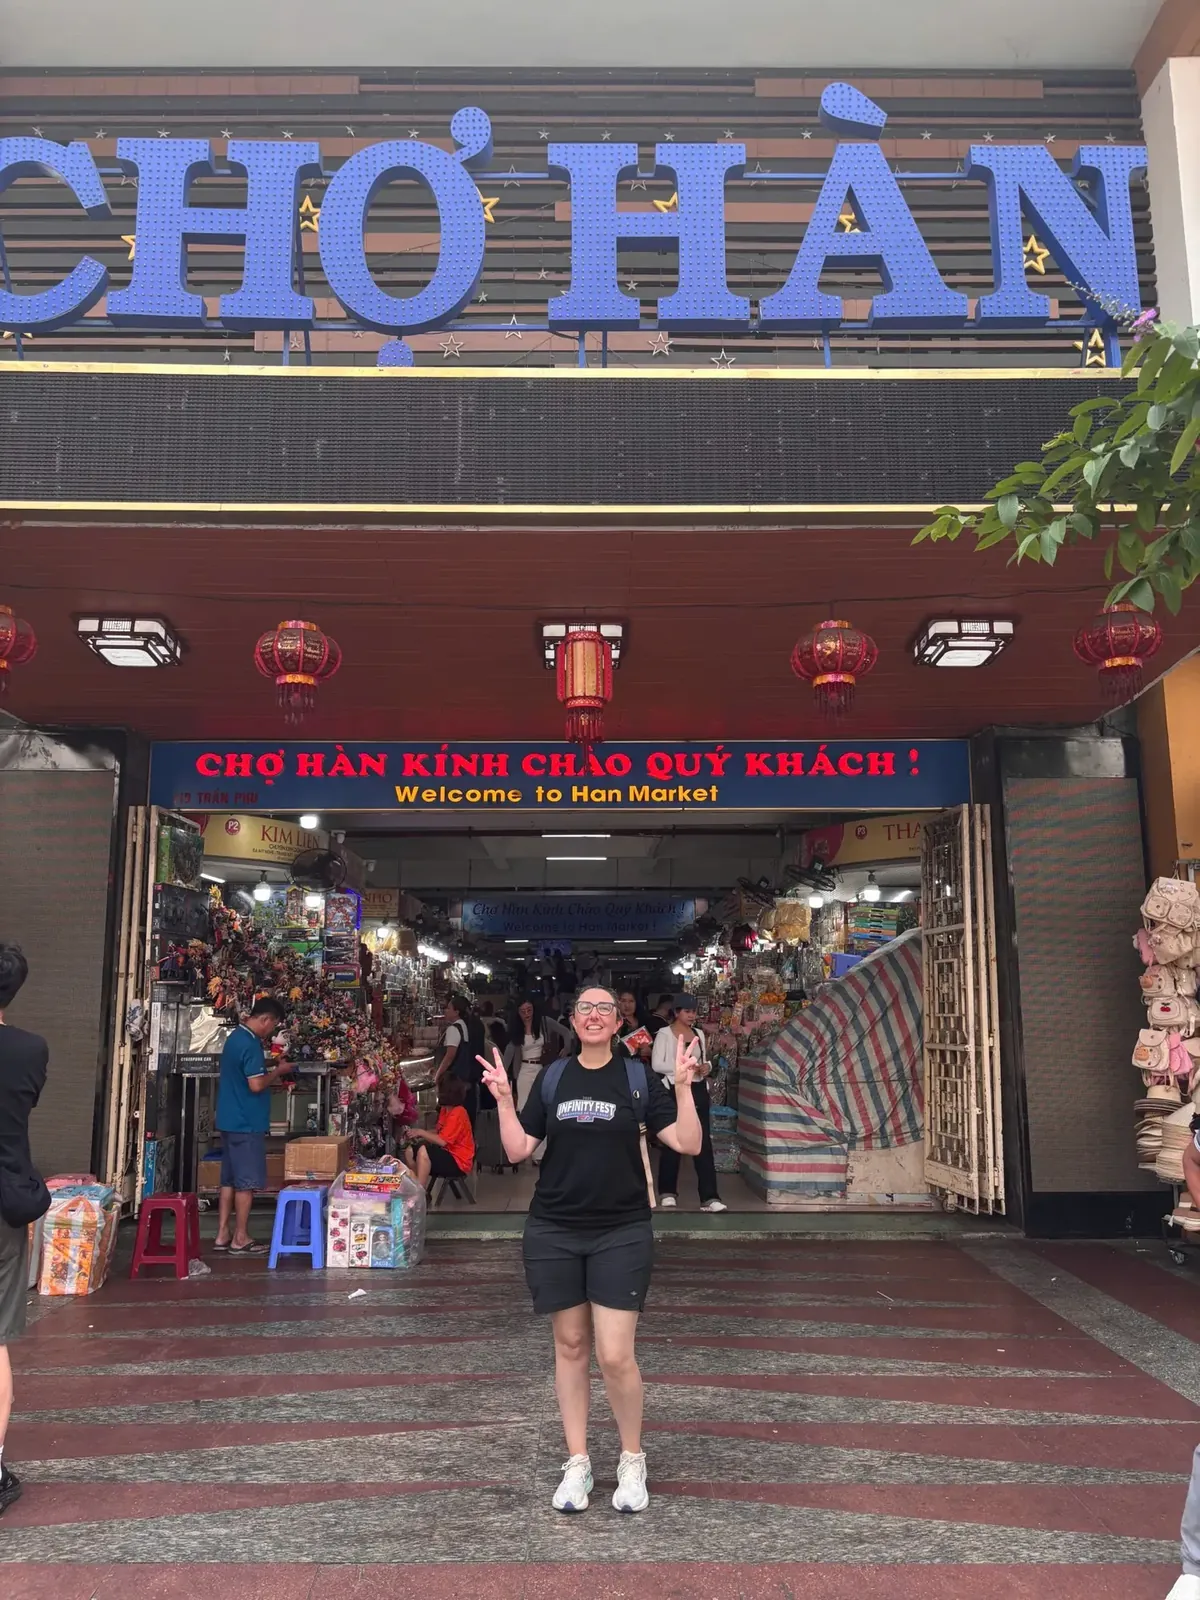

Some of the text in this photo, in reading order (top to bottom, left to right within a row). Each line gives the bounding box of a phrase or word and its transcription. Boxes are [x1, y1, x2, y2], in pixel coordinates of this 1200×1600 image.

[547, 82, 1148, 325] HÀN
[195, 743, 919, 785] CHỢ HÀN KÍNH CHÀO QUÝ KHÁCH !
[395, 785, 718, 803] Welcome to Han Market
[228, 820, 238, 831] P2
[261, 825, 293, 844] KIM
[558, 1100, 593, 1116] INFINITY
[595, 1101, 614, 1116] FEST
